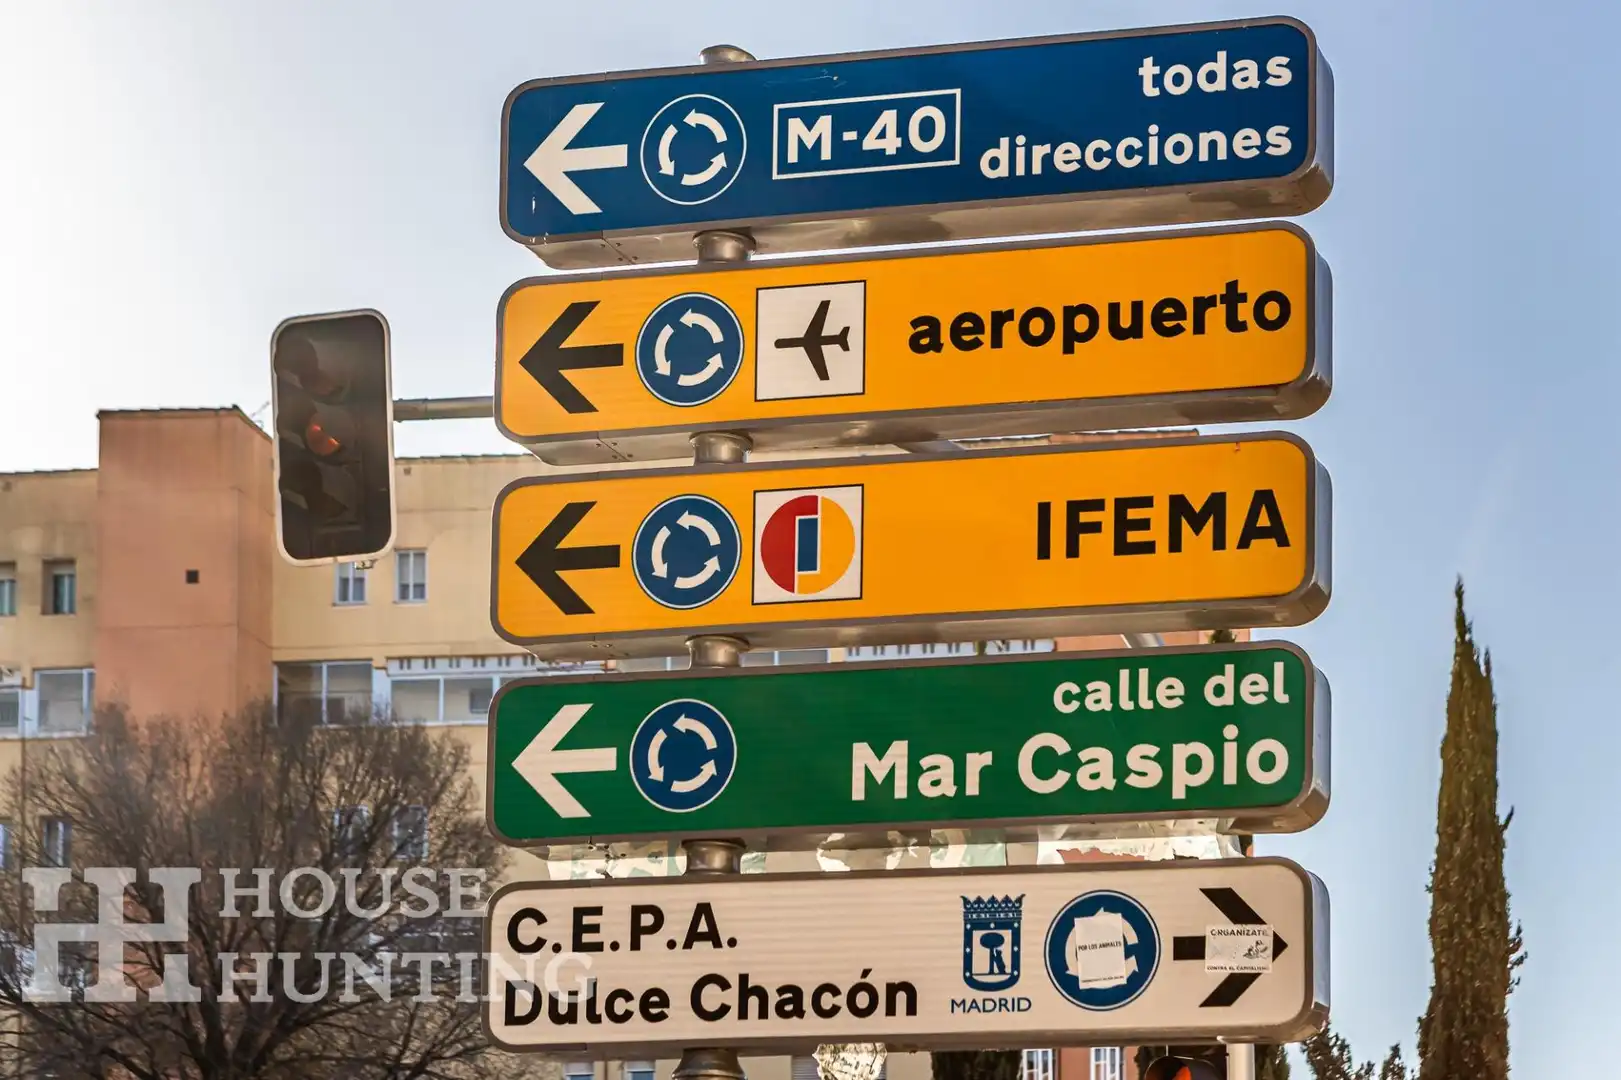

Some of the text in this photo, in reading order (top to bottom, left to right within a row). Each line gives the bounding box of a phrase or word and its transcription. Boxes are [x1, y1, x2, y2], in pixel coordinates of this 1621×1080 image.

[1138, 51, 1292, 97] todas
[786, 105, 946, 164] M-40
[979, 124, 1293, 179] direcciones
[908, 279, 1291, 355] aeropuerto
[1036, 488, 1291, 561] IFEMA
[1053, 661, 1290, 713] calle del
[851, 723, 1290, 801] Mar Caspio
[506, 902, 738, 954] C.E.P.A.
[504, 968, 919, 1026] Dulce Chacón
[950, 997, 1032, 1014] MADRID
